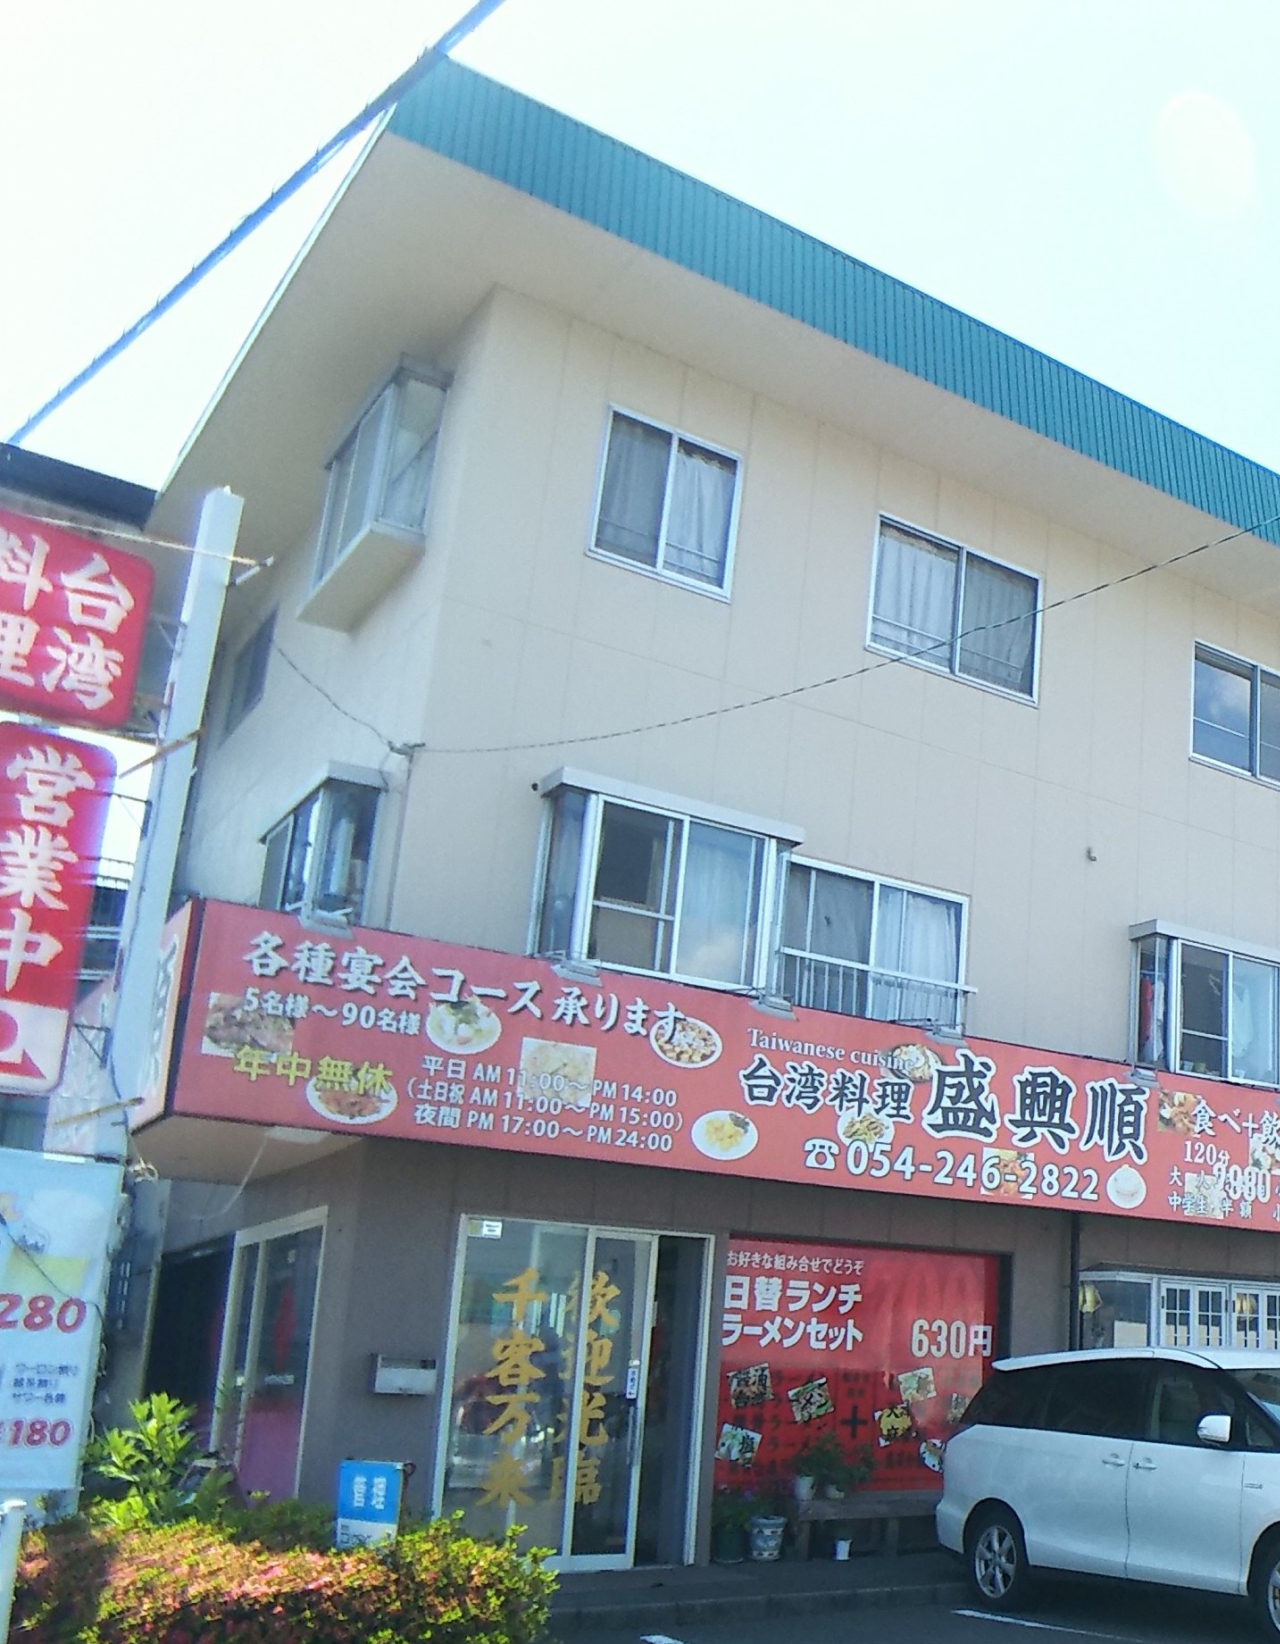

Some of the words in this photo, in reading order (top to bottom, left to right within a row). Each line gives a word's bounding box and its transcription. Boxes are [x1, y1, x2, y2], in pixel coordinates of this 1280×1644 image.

[42, 551, 135, 711] 台湾
[0, 744, 96, 993] 営業中
[243, 930, 686, 1037] 各種宴会コース承ります
[747, 1027, 845, 1062] Taiwanese
[234, 1045, 394, 1096] 年中無休
[422, 1055, 467, 1080] 平日
[473, 1063, 501, 1083] AM
[622, 1084, 677, 1107] 14:00
[740, 1053, 916, 1124] 台湾料理
[470, 1086, 497, 1107] AM
[414, 1103, 460, 1129] 夜間
[466, 1112, 493, 1131] PM
[615, 1127, 673, 1152] 24:00
[846, 1138, 1100, 1202] 054-246-2822
[723, 1274, 863, 1315] 日替ランチ
[721, 1313, 864, 1351] ラーメンセット
[911, 1318, 993, 1359] 630円
